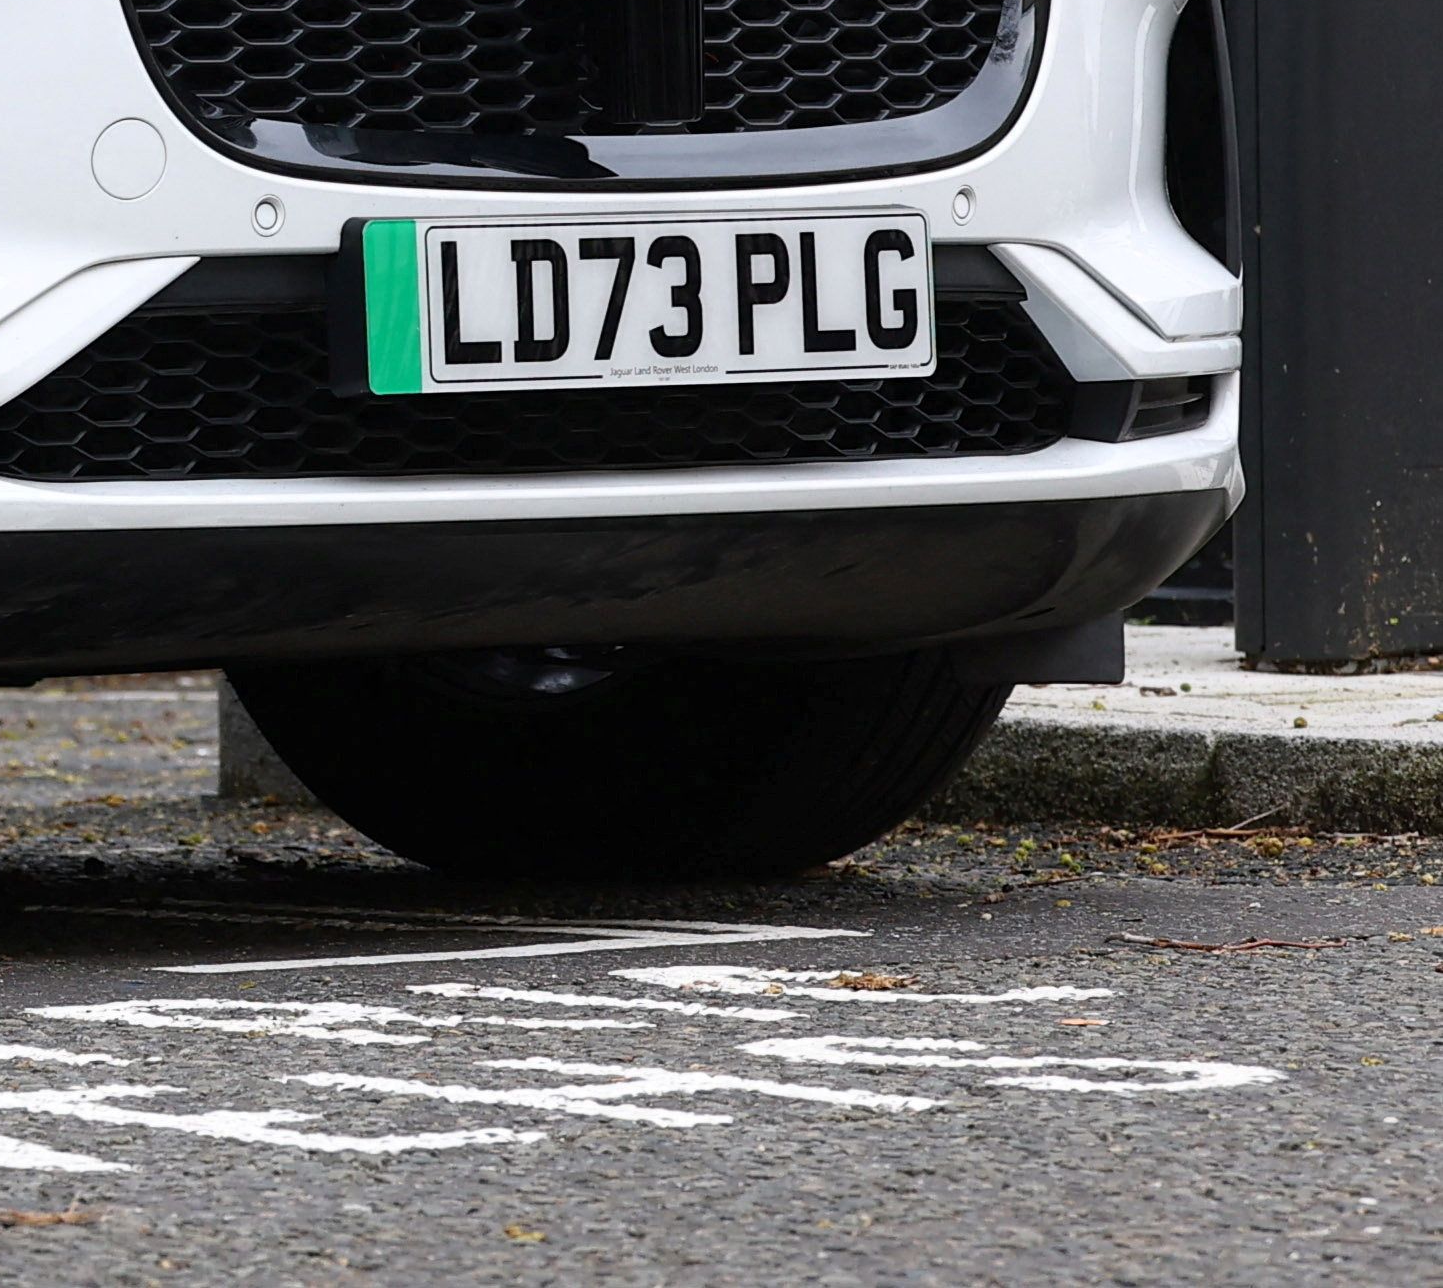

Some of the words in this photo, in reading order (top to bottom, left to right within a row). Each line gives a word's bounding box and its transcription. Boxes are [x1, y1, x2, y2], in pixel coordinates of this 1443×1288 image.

[441, 235, 704, 366] LD73
[735, 229, 919, 355] PLG
[610, 367, 632, 379] Jaguar
[634, 365, 651, 375] Land
[653, 365, 672, 375] Rover
[674, 364, 691, 374] West
[693, 363, 719, 373] London
